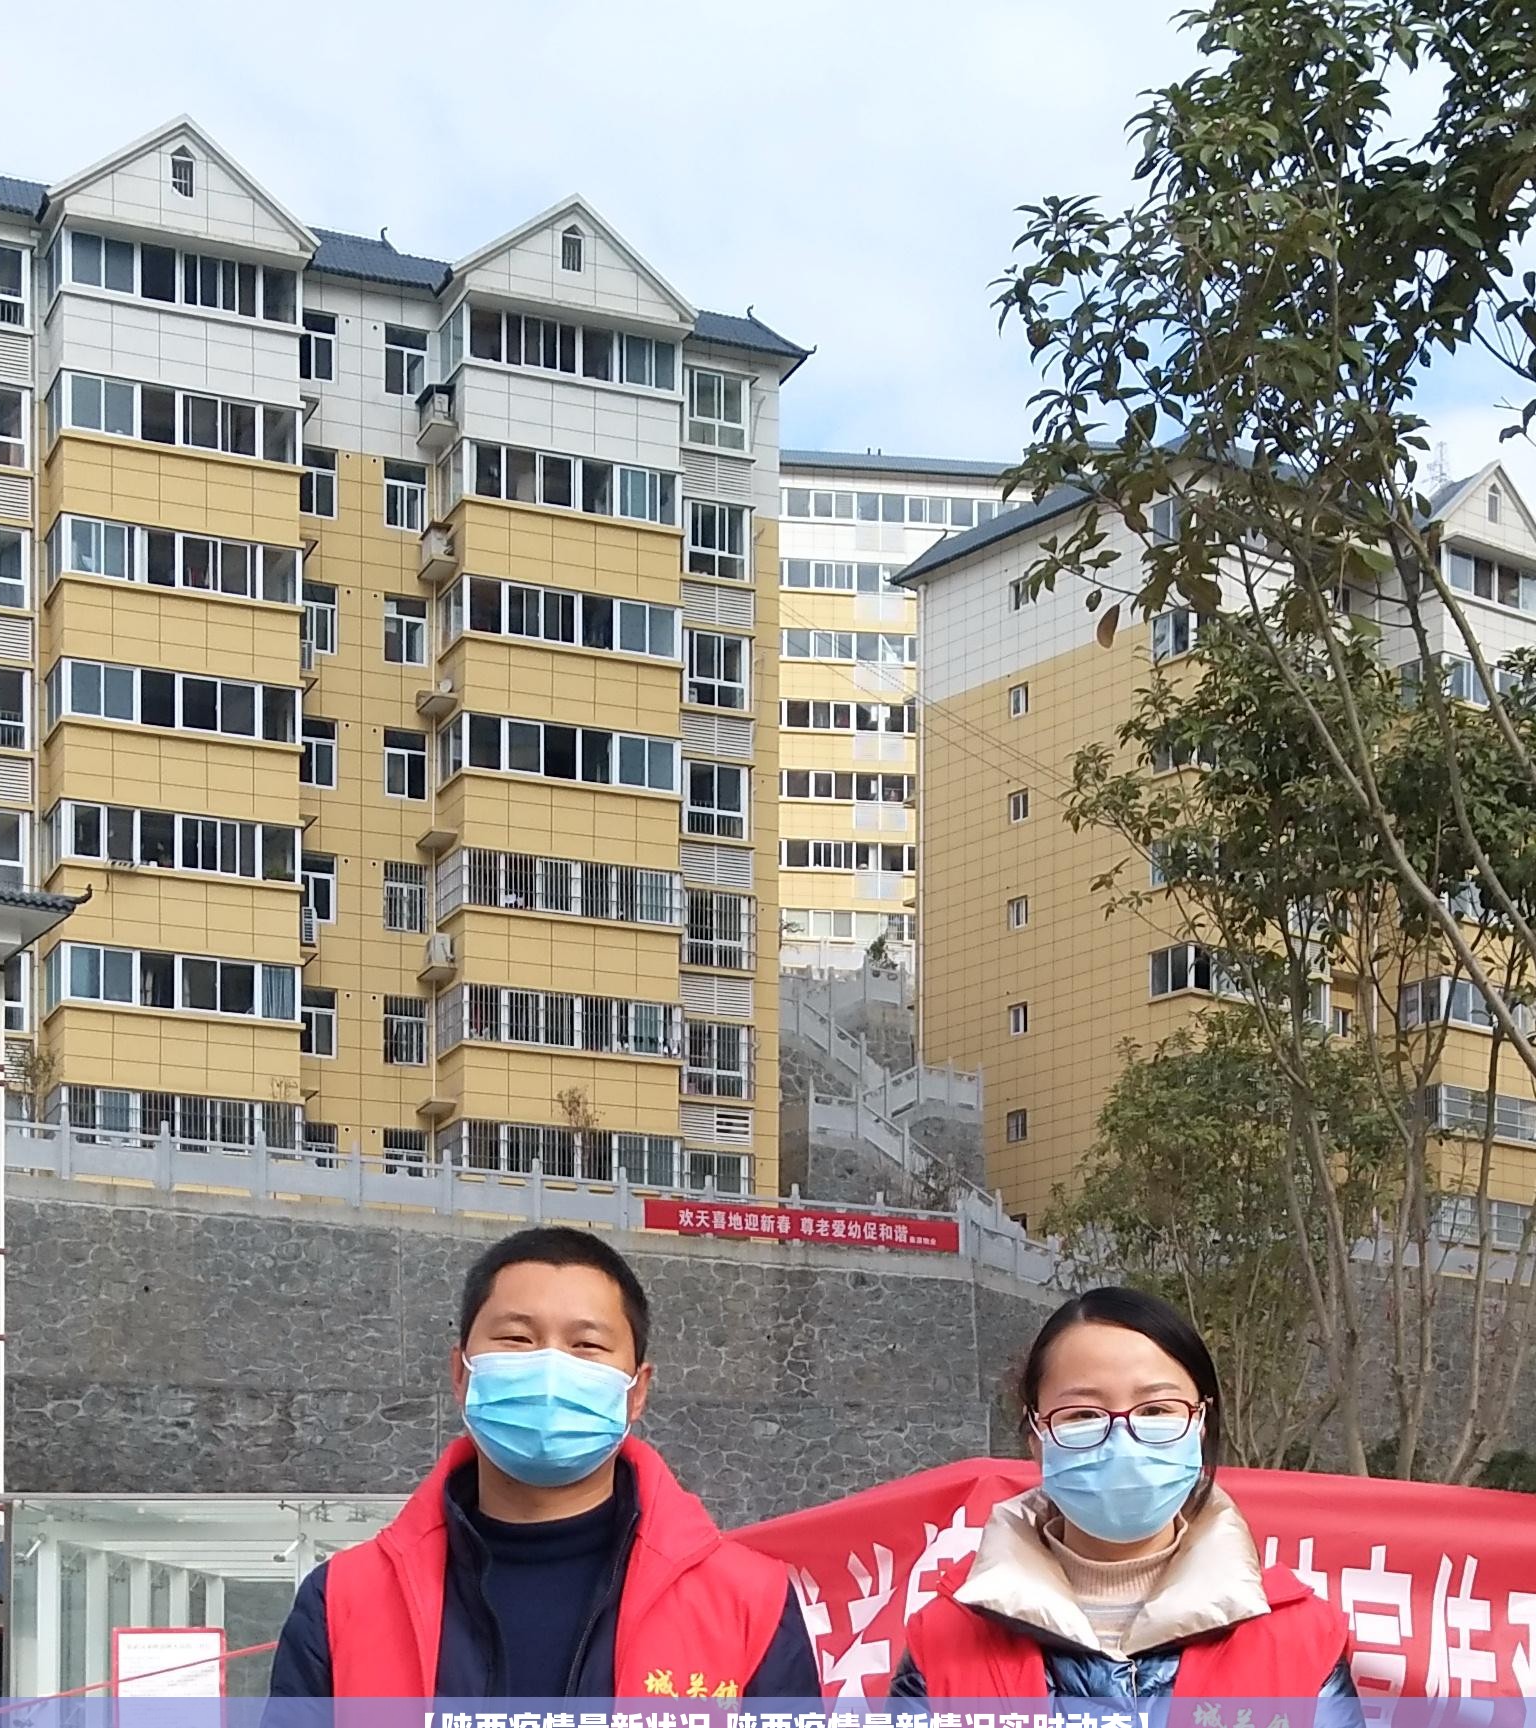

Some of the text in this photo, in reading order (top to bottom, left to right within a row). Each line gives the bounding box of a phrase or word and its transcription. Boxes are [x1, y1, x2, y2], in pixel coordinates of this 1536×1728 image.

[678, 1208, 791, 1234] 欢天喜地迎新春
[799, 1217, 909, 1243] 尊老爱幼促和谐
[644, 1668, 739, 1712] 城关镇
